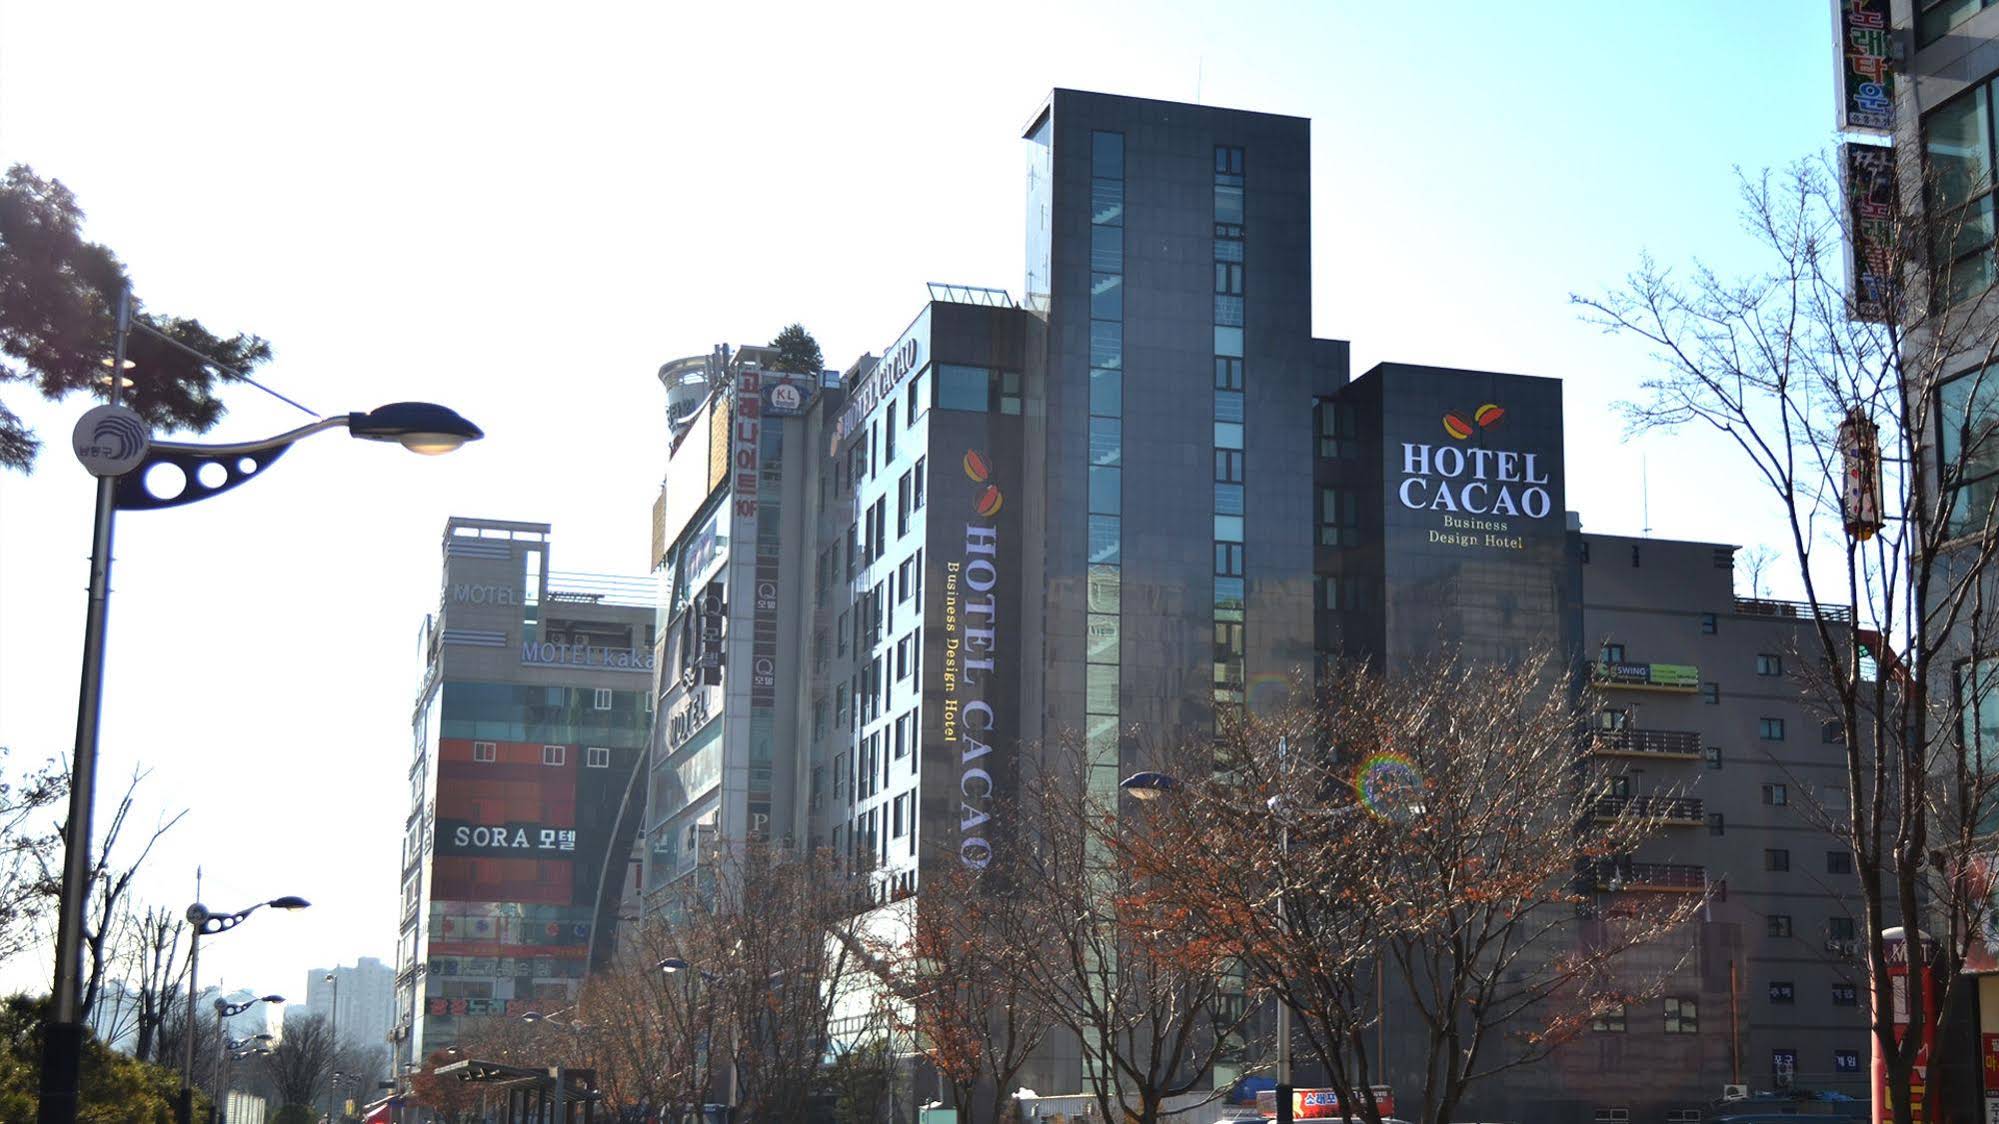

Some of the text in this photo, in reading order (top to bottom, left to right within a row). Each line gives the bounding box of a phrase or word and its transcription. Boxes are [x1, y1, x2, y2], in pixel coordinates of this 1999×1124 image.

[1849, 0, 1889, 113] 노래타운
[843, 337, 918, 440] HOTEL CACAO
[1401, 442, 1548, 484] HOTEL
[1399, 477, 1551, 519] CACAO
[1443, 515, 1508, 531] Business
[1429, 530, 1523, 549] Design Hotel
[454, 583, 520, 605] MOTEL
[759, 583, 776, 600] Q
[522, 641, 594, 665] MOTEL
[944, 562, 960, 742] Business Design Hotel
[756, 659, 774, 676] Q
[1618, 665, 1647, 676] SWING
[960, 523, 998, 870] HOTEL CACAO
[752, 813, 768, 831] P
[454, 826, 577, 851] SORA 모텔
